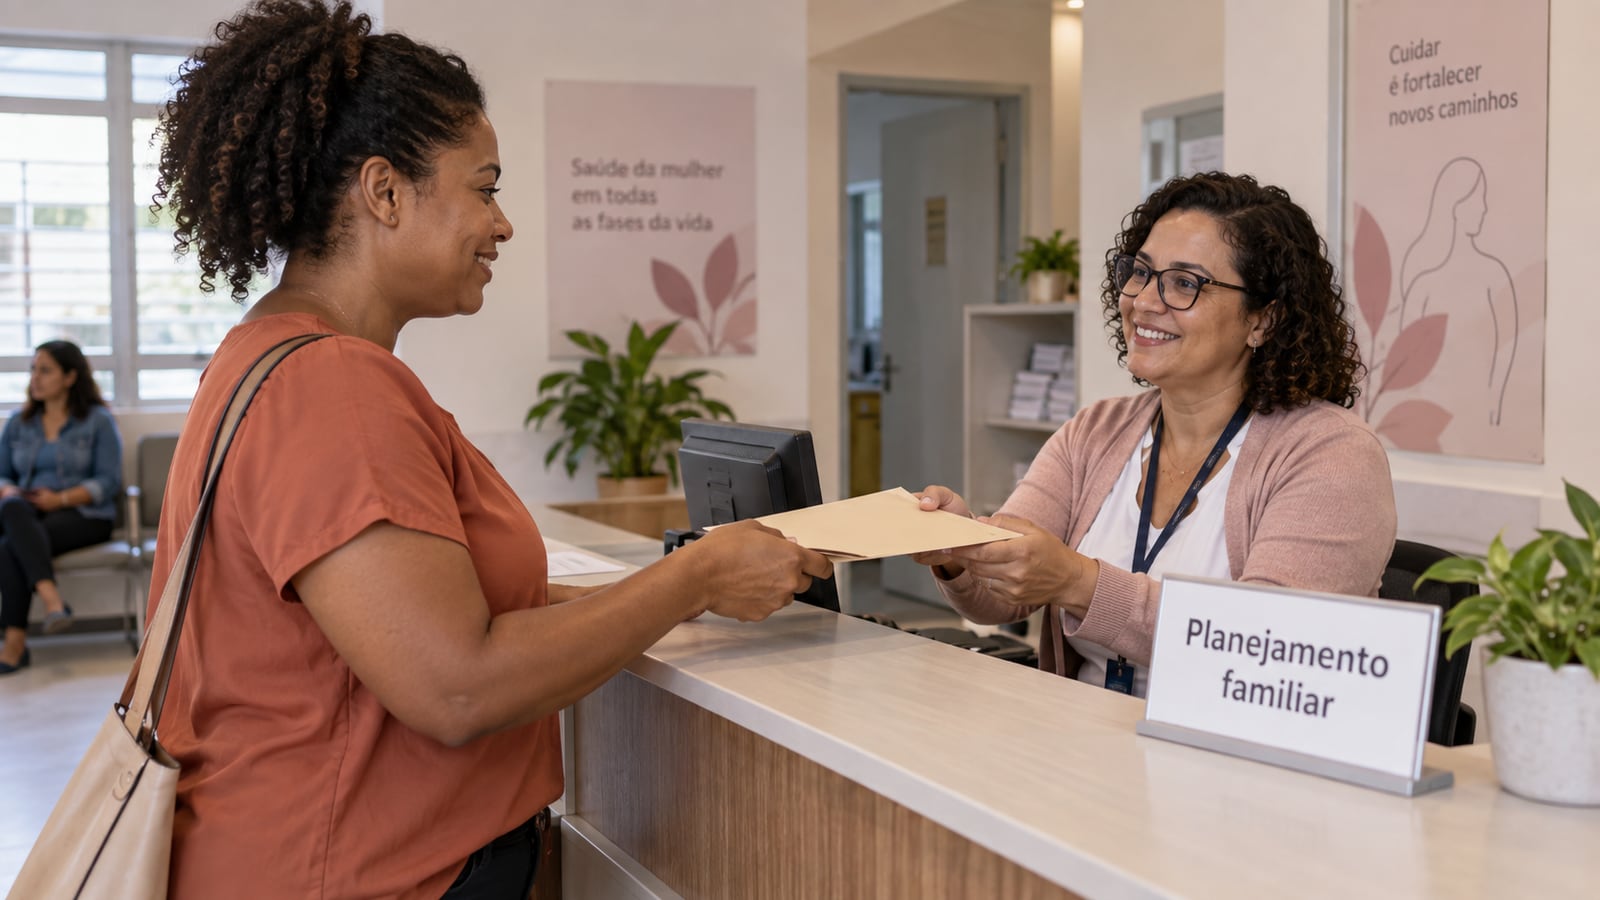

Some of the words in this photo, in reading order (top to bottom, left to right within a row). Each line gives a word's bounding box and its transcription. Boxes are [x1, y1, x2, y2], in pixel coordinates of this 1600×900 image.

[1389, 38, 1441, 65] Cuidar
[1389, 74, 1399, 96] é
[1403, 65, 1482, 94] fortalecer
[1389, 105, 1434, 127] novos
[1438, 90, 1518, 119] caminhos
[571, 158, 628, 178] Saúde
[633, 159, 656, 178] da
[661, 159, 724, 179] mulher
[571, 188, 602, 204] em
[607, 185, 658, 205] todas
[572, 216, 592, 231] as
[598, 212, 644, 231] fases
[649, 213, 671, 231] da
[676, 213, 713, 231] vida
[1186, 617, 1389, 678] Planejamento
[1222, 669, 1335, 718] familiar
